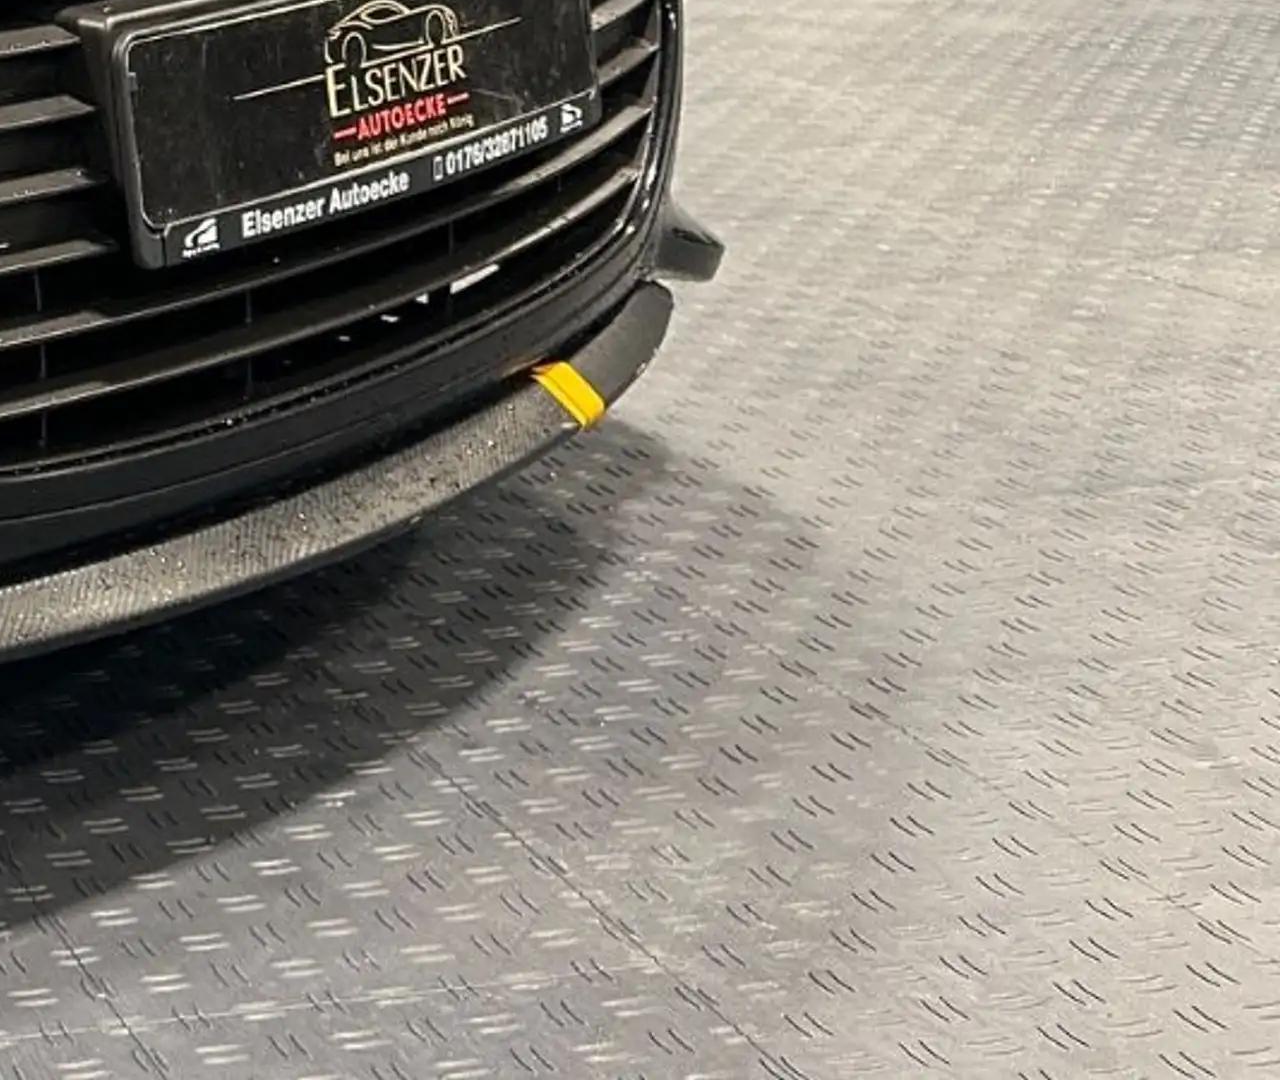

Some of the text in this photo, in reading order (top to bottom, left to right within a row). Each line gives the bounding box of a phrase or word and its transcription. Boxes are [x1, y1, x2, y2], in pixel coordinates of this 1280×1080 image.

[326, 45, 467, 117] ELSENZER
[358, 94, 447, 139] AUTOECKE
[242, 195, 327, 238] Elsenzer
[329, 170, 411, 214] Autoecke
